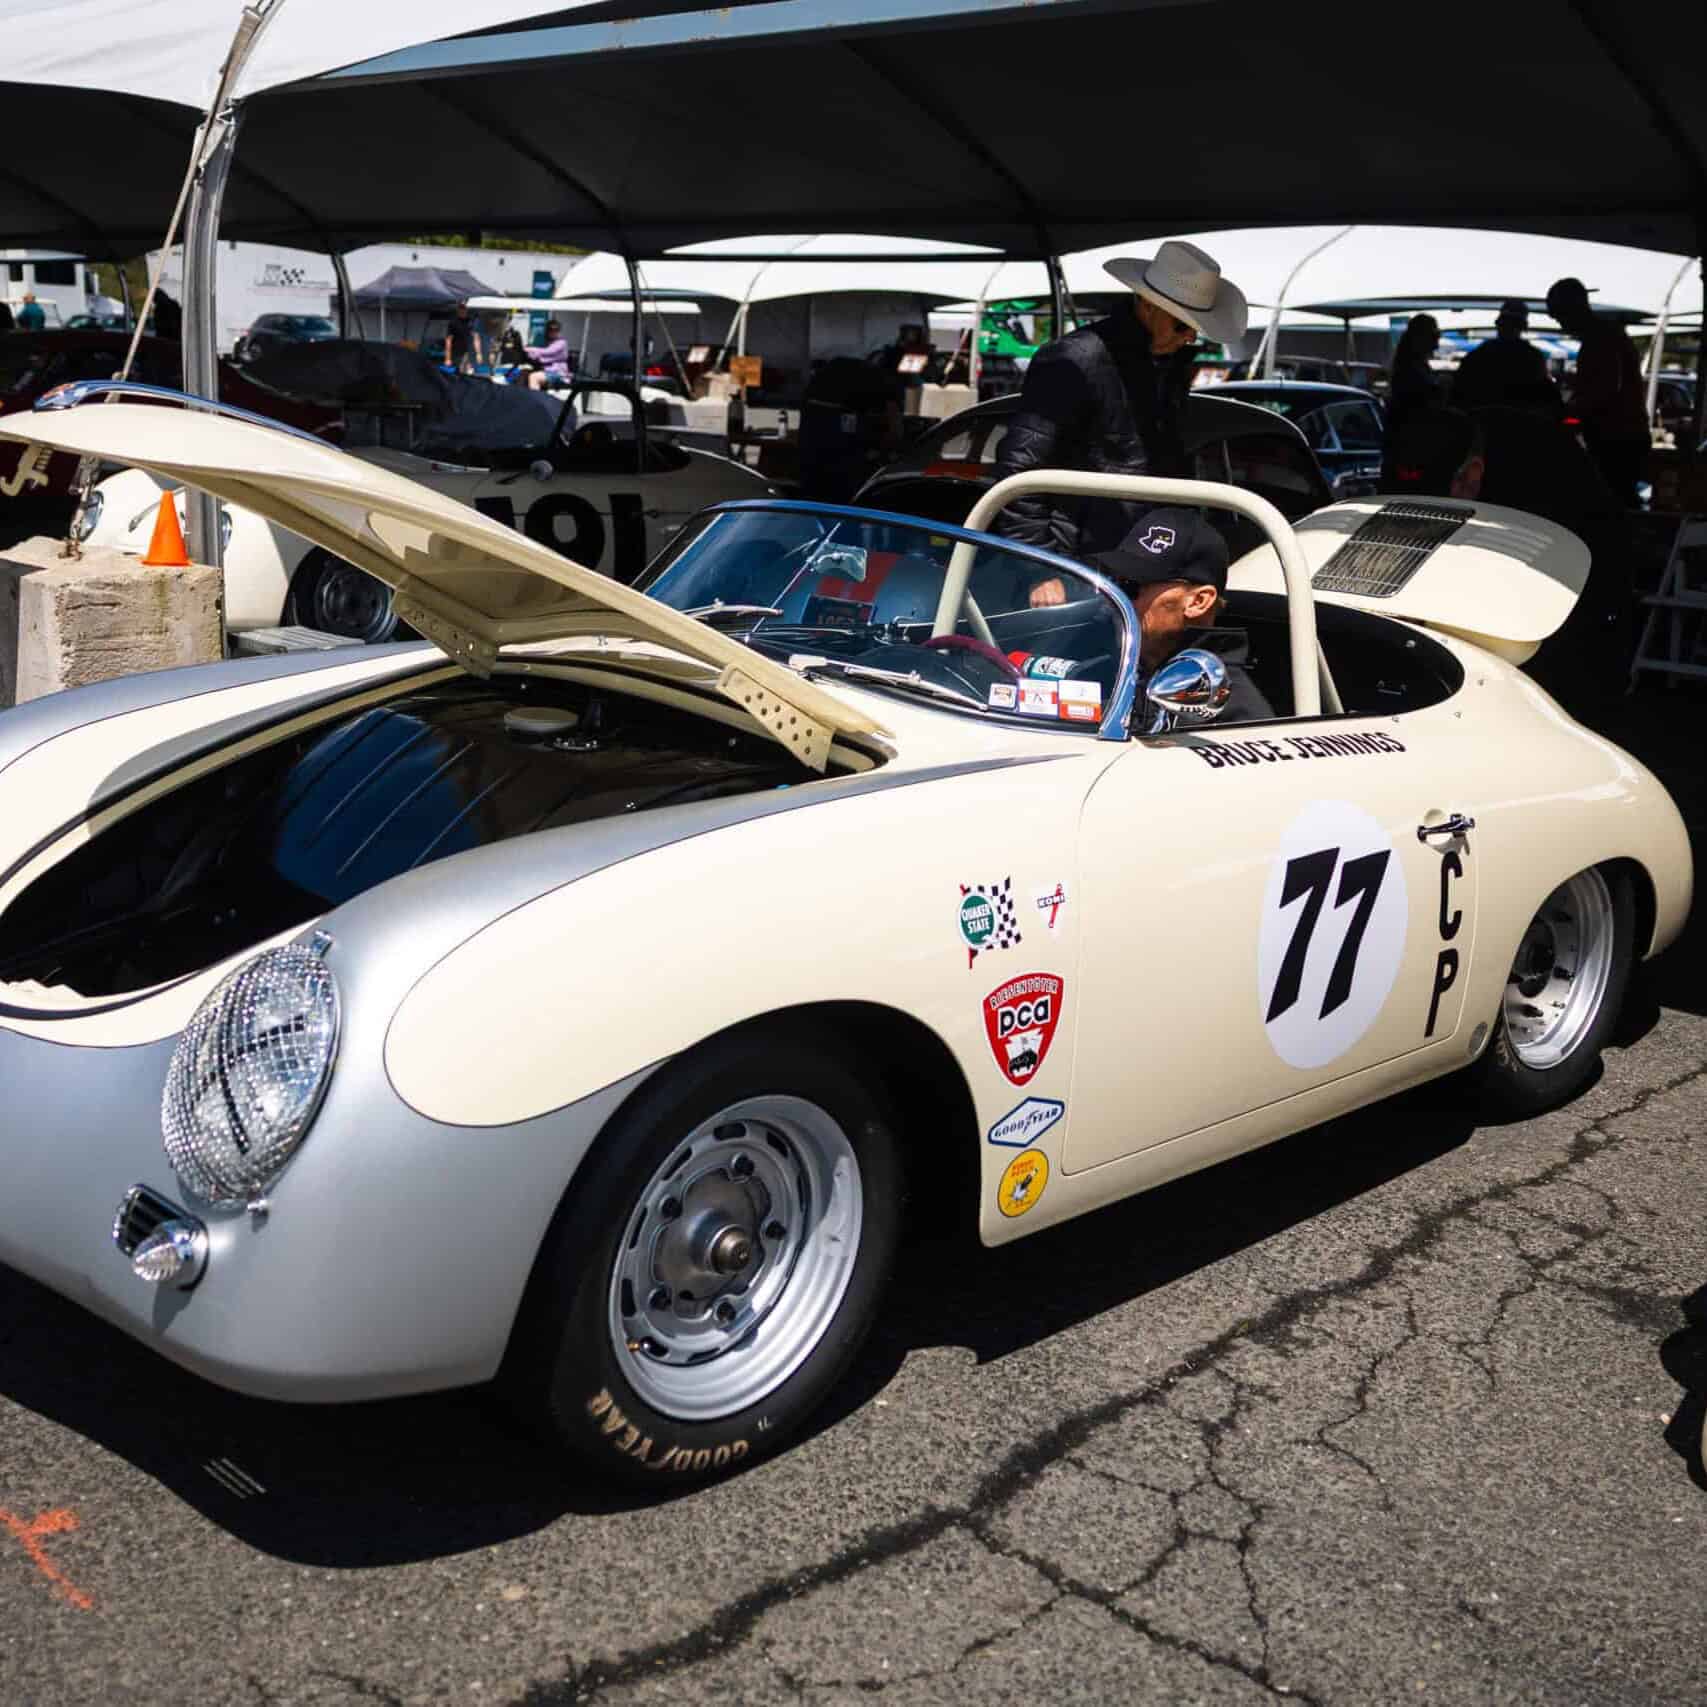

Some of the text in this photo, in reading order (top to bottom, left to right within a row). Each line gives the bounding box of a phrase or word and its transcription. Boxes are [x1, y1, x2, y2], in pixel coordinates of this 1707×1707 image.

[1189, 731, 1406, 768] BRUCE JENNINGS
[961, 903, 991, 922] QUAKER
[967, 918, 990, 935] STATE
[1265, 847, 1391, 1024] 77
[999, 997, 1050, 1037] pca
